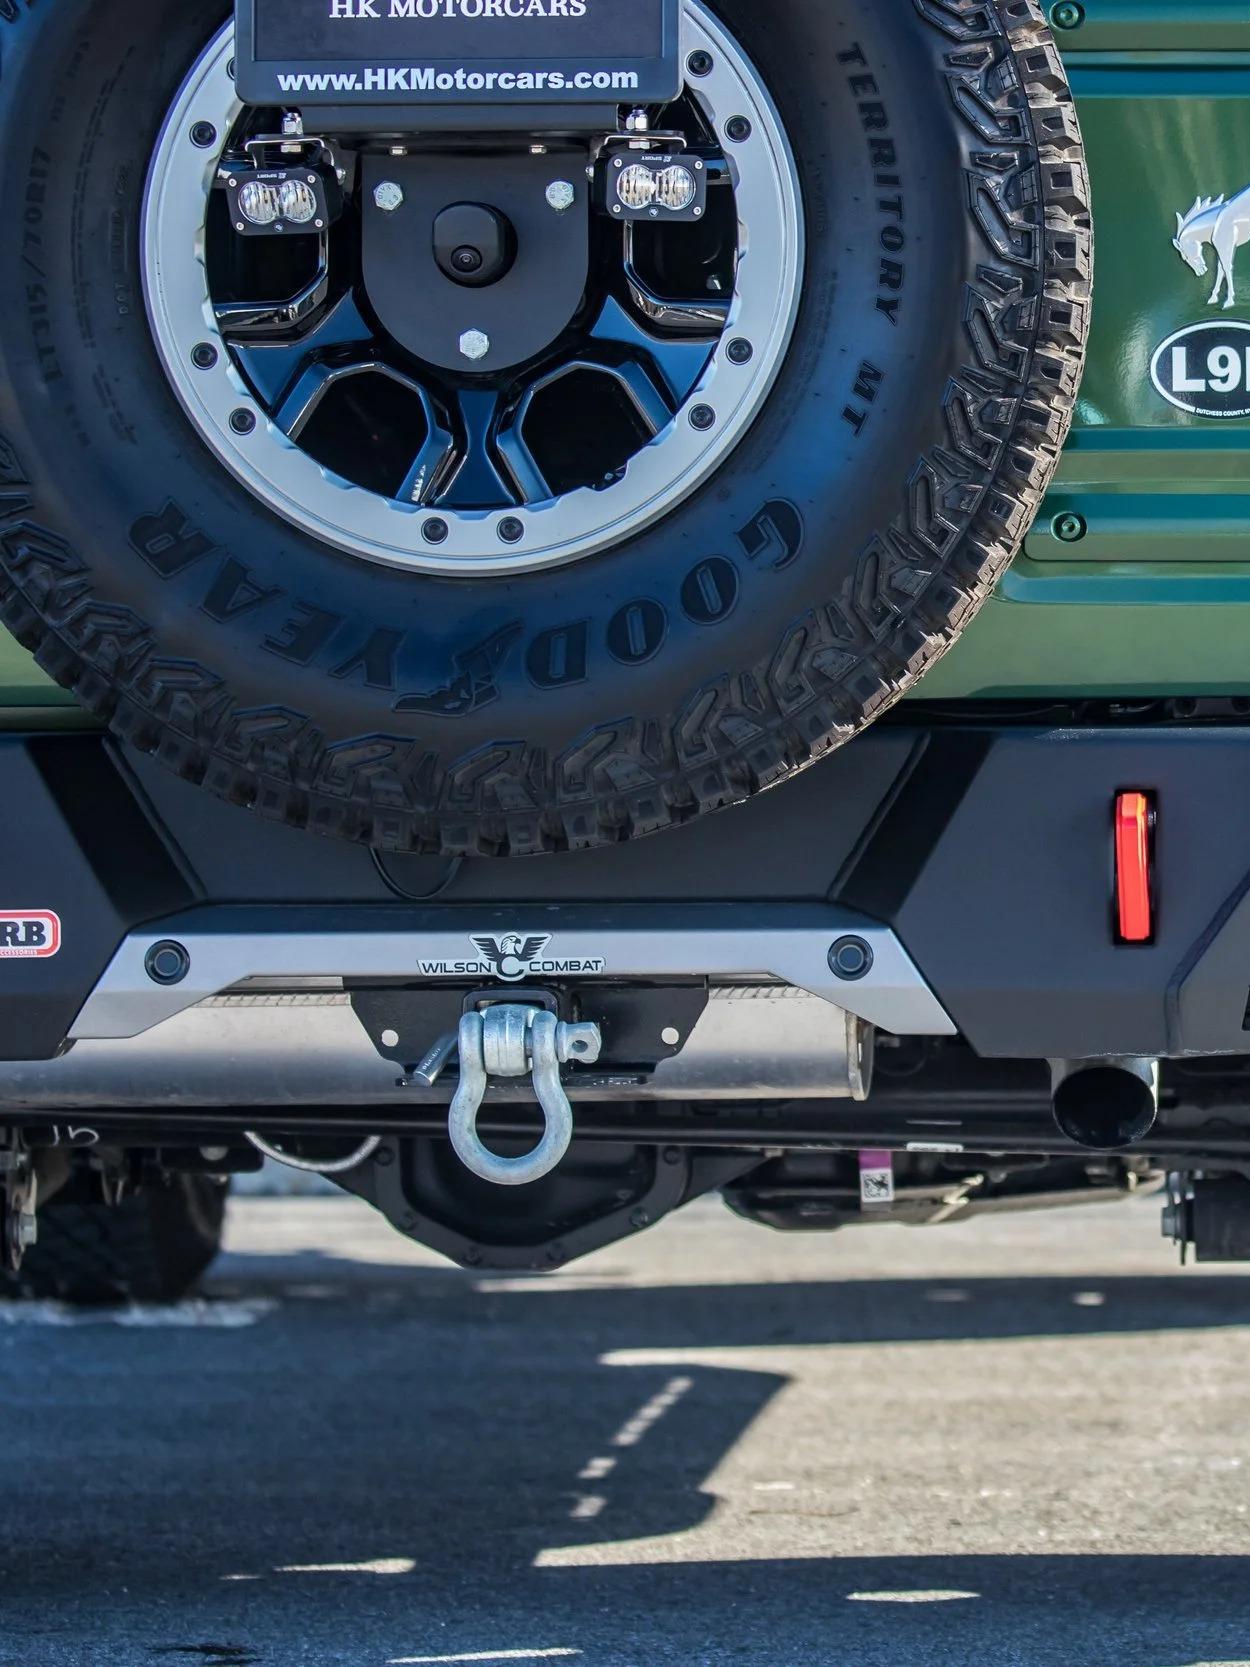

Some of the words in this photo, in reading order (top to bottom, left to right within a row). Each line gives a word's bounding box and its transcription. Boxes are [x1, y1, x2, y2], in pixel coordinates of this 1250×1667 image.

[329, 0, 381, 18] HK
[388, 0, 587, 18] MOTORCARS
[277, 68, 638, 92] www.HKMotorcars.com
[836, 41, 905, 328] TERRITORY
[841, 359, 887, 437] MT
[1196, 407, 1223, 416] DUTCHESS
[128, 497, 805, 692] GOODYEAR
[0, 921, 46, 946] RB
[421, 962, 492, 973] WILSON
[529, 960, 602, 972] COMBAT
